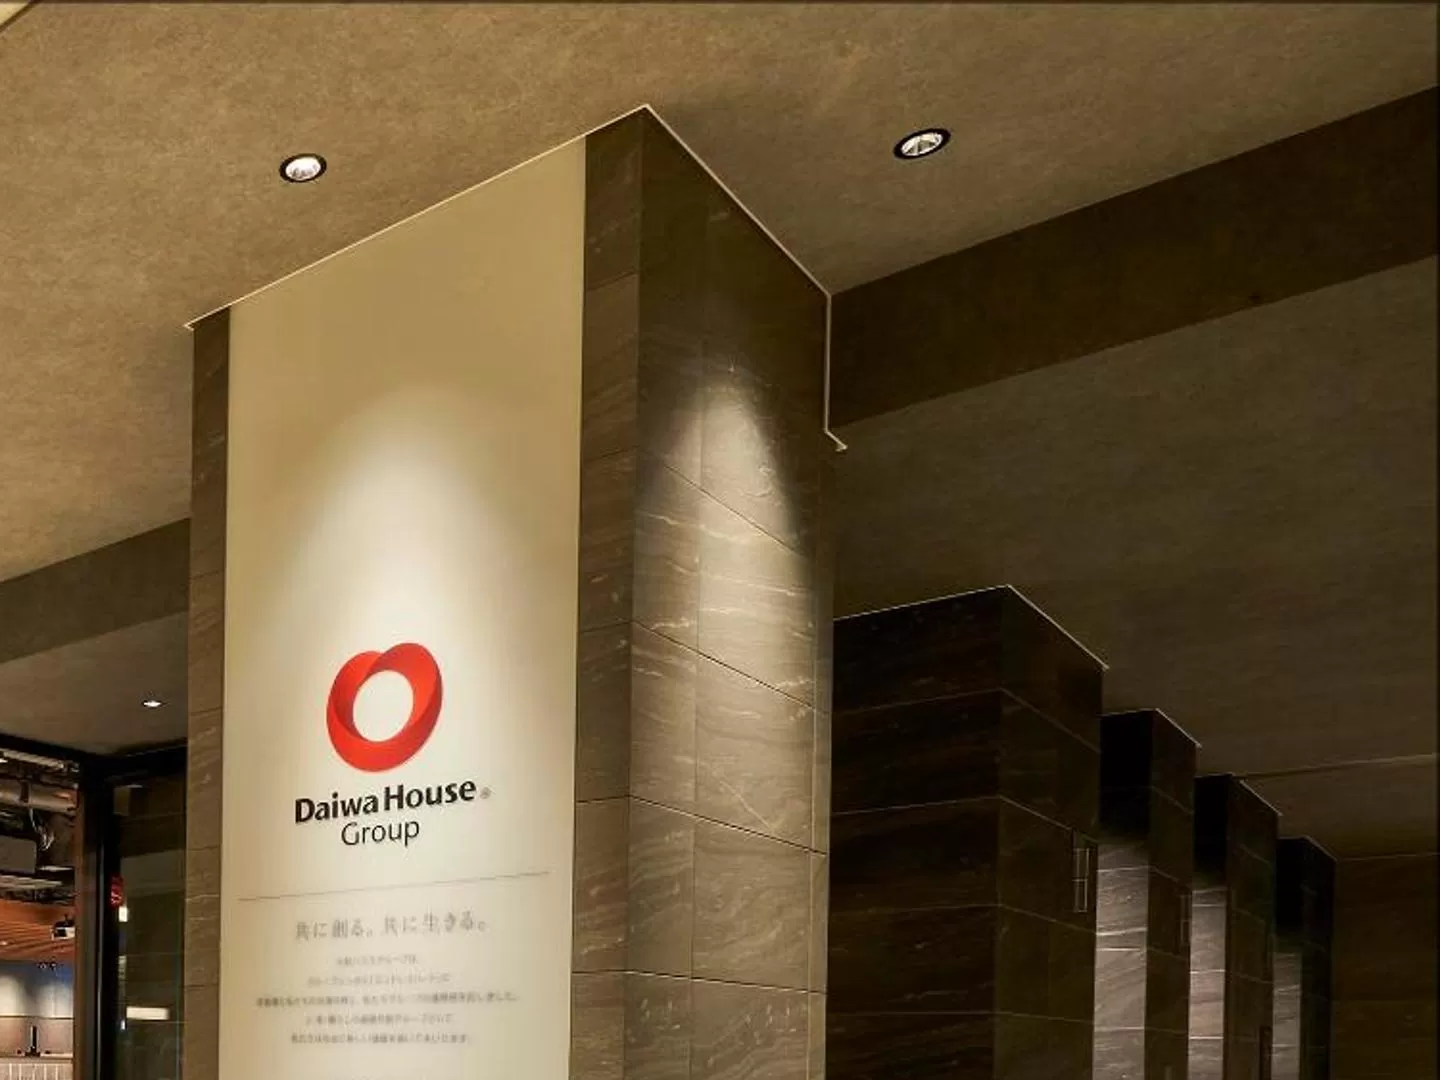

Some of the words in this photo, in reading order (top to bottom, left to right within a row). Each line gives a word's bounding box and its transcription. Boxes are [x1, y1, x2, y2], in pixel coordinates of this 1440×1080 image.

[294, 792, 379, 824] Daiwa
[383, 780, 477, 811] House
[340, 820, 420, 847] Group
